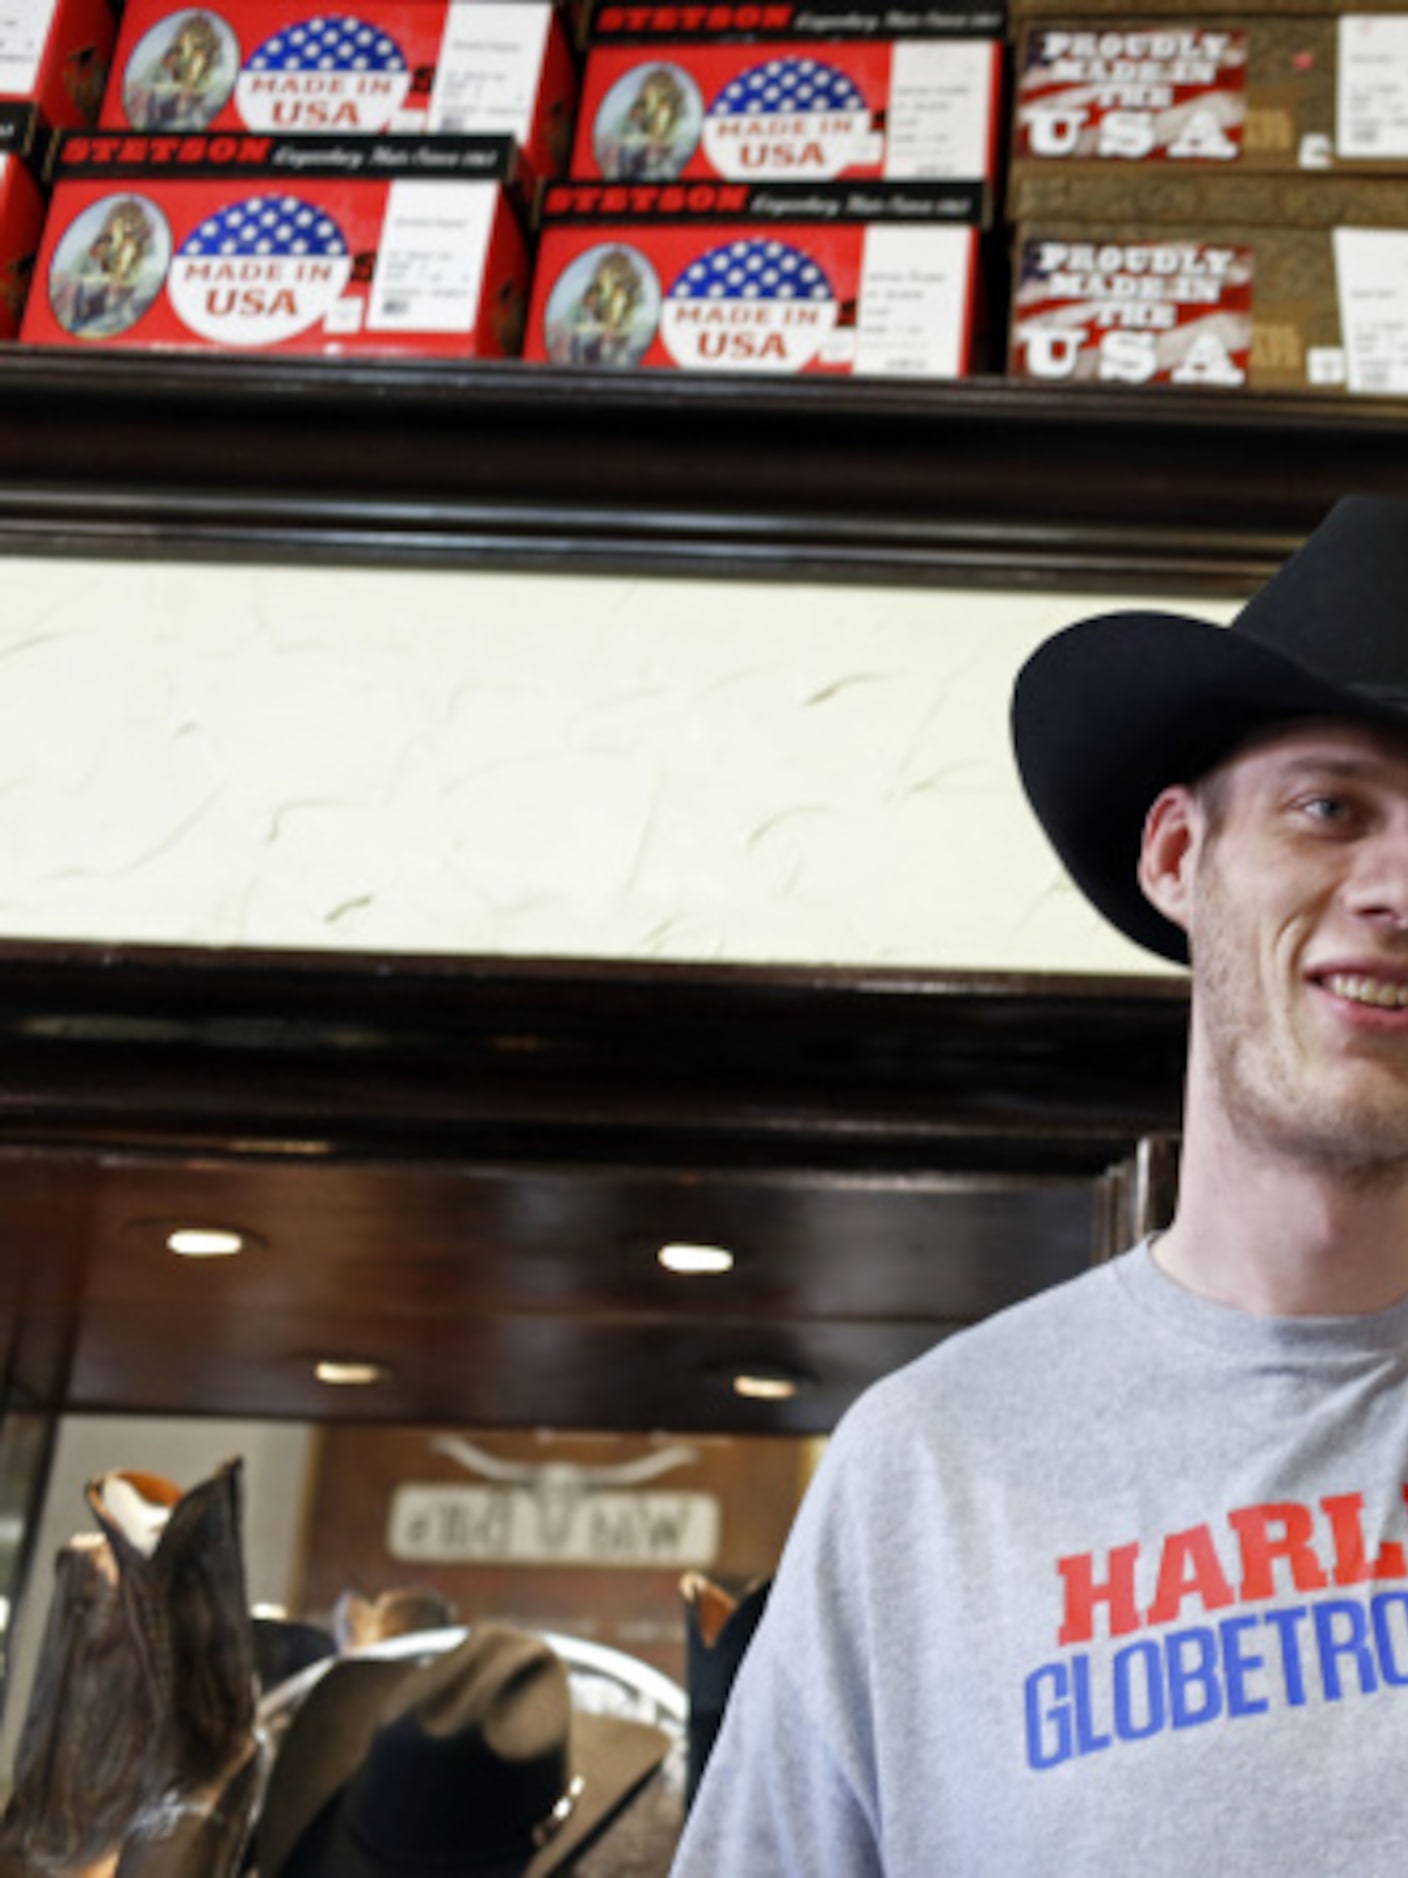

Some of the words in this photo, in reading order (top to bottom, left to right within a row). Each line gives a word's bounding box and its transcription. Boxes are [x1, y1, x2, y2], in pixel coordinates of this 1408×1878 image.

[597, 3, 794, 32] STETSON
[1042, 30, 1228, 61] PROUDLY
[1051, 58, 1164, 83] MADE
[1173, 61, 1218, 84] IN
[251, 76, 346, 94] MADE
[356, 76, 391, 95] IN
[1097, 83, 1174, 108] THE
[272, 101, 360, 127] USA
[717, 118, 807, 138] MADE
[818, 118, 853, 135] IN
[1022, 109, 1239, 158] USA
[60, 137, 273, 164] STETSON
[738, 142, 827, 168] USA
[544, 185, 750, 213] STETSON
[183, 262, 285, 282] MADE
[296, 263, 332, 282] IN
[1040, 243, 1235, 277] PROUDLY
[1049, 273, 1168, 300] MADE
[1176, 277, 1222, 302] IN
[205, 289, 298, 316] USA
[674, 305, 773, 326] MADE
[785, 307, 819, 326] IN
[1096, 300, 1176, 328] THE
[698, 331, 788, 360] USA
[1018, 327, 1246, 387] USA
